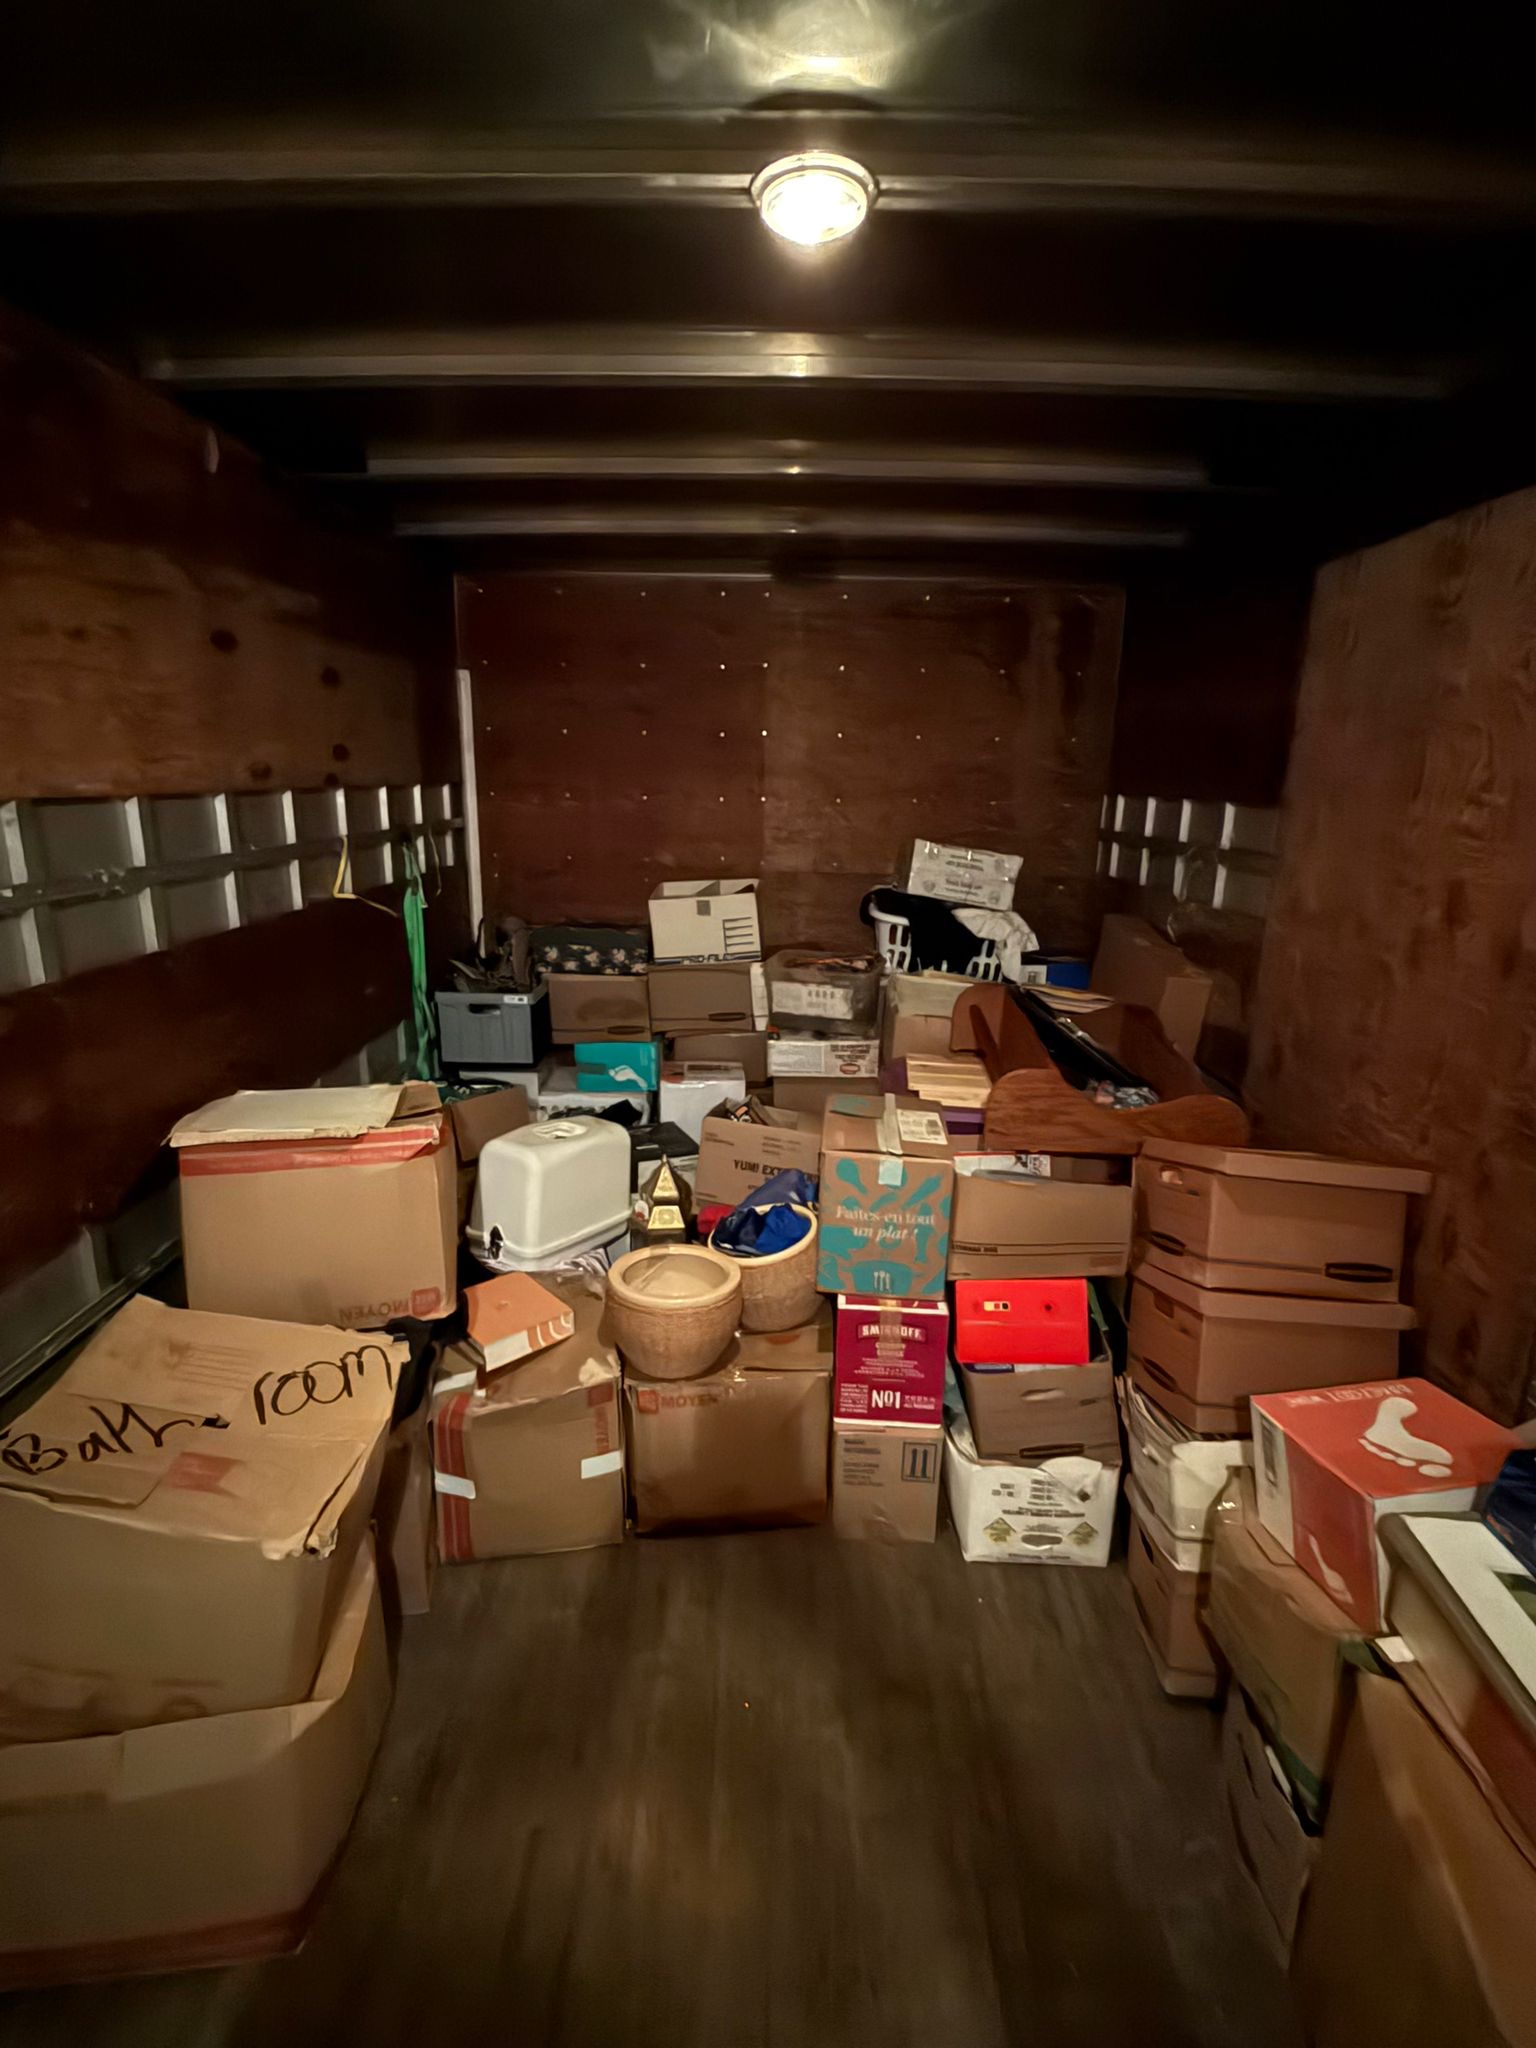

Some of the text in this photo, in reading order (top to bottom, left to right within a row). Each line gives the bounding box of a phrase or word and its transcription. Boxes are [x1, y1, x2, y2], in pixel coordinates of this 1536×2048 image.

[853, 1226, 873, 1237] un
[876, 1225, 908, 1243] plat
[253, 1345, 393, 1425] room
